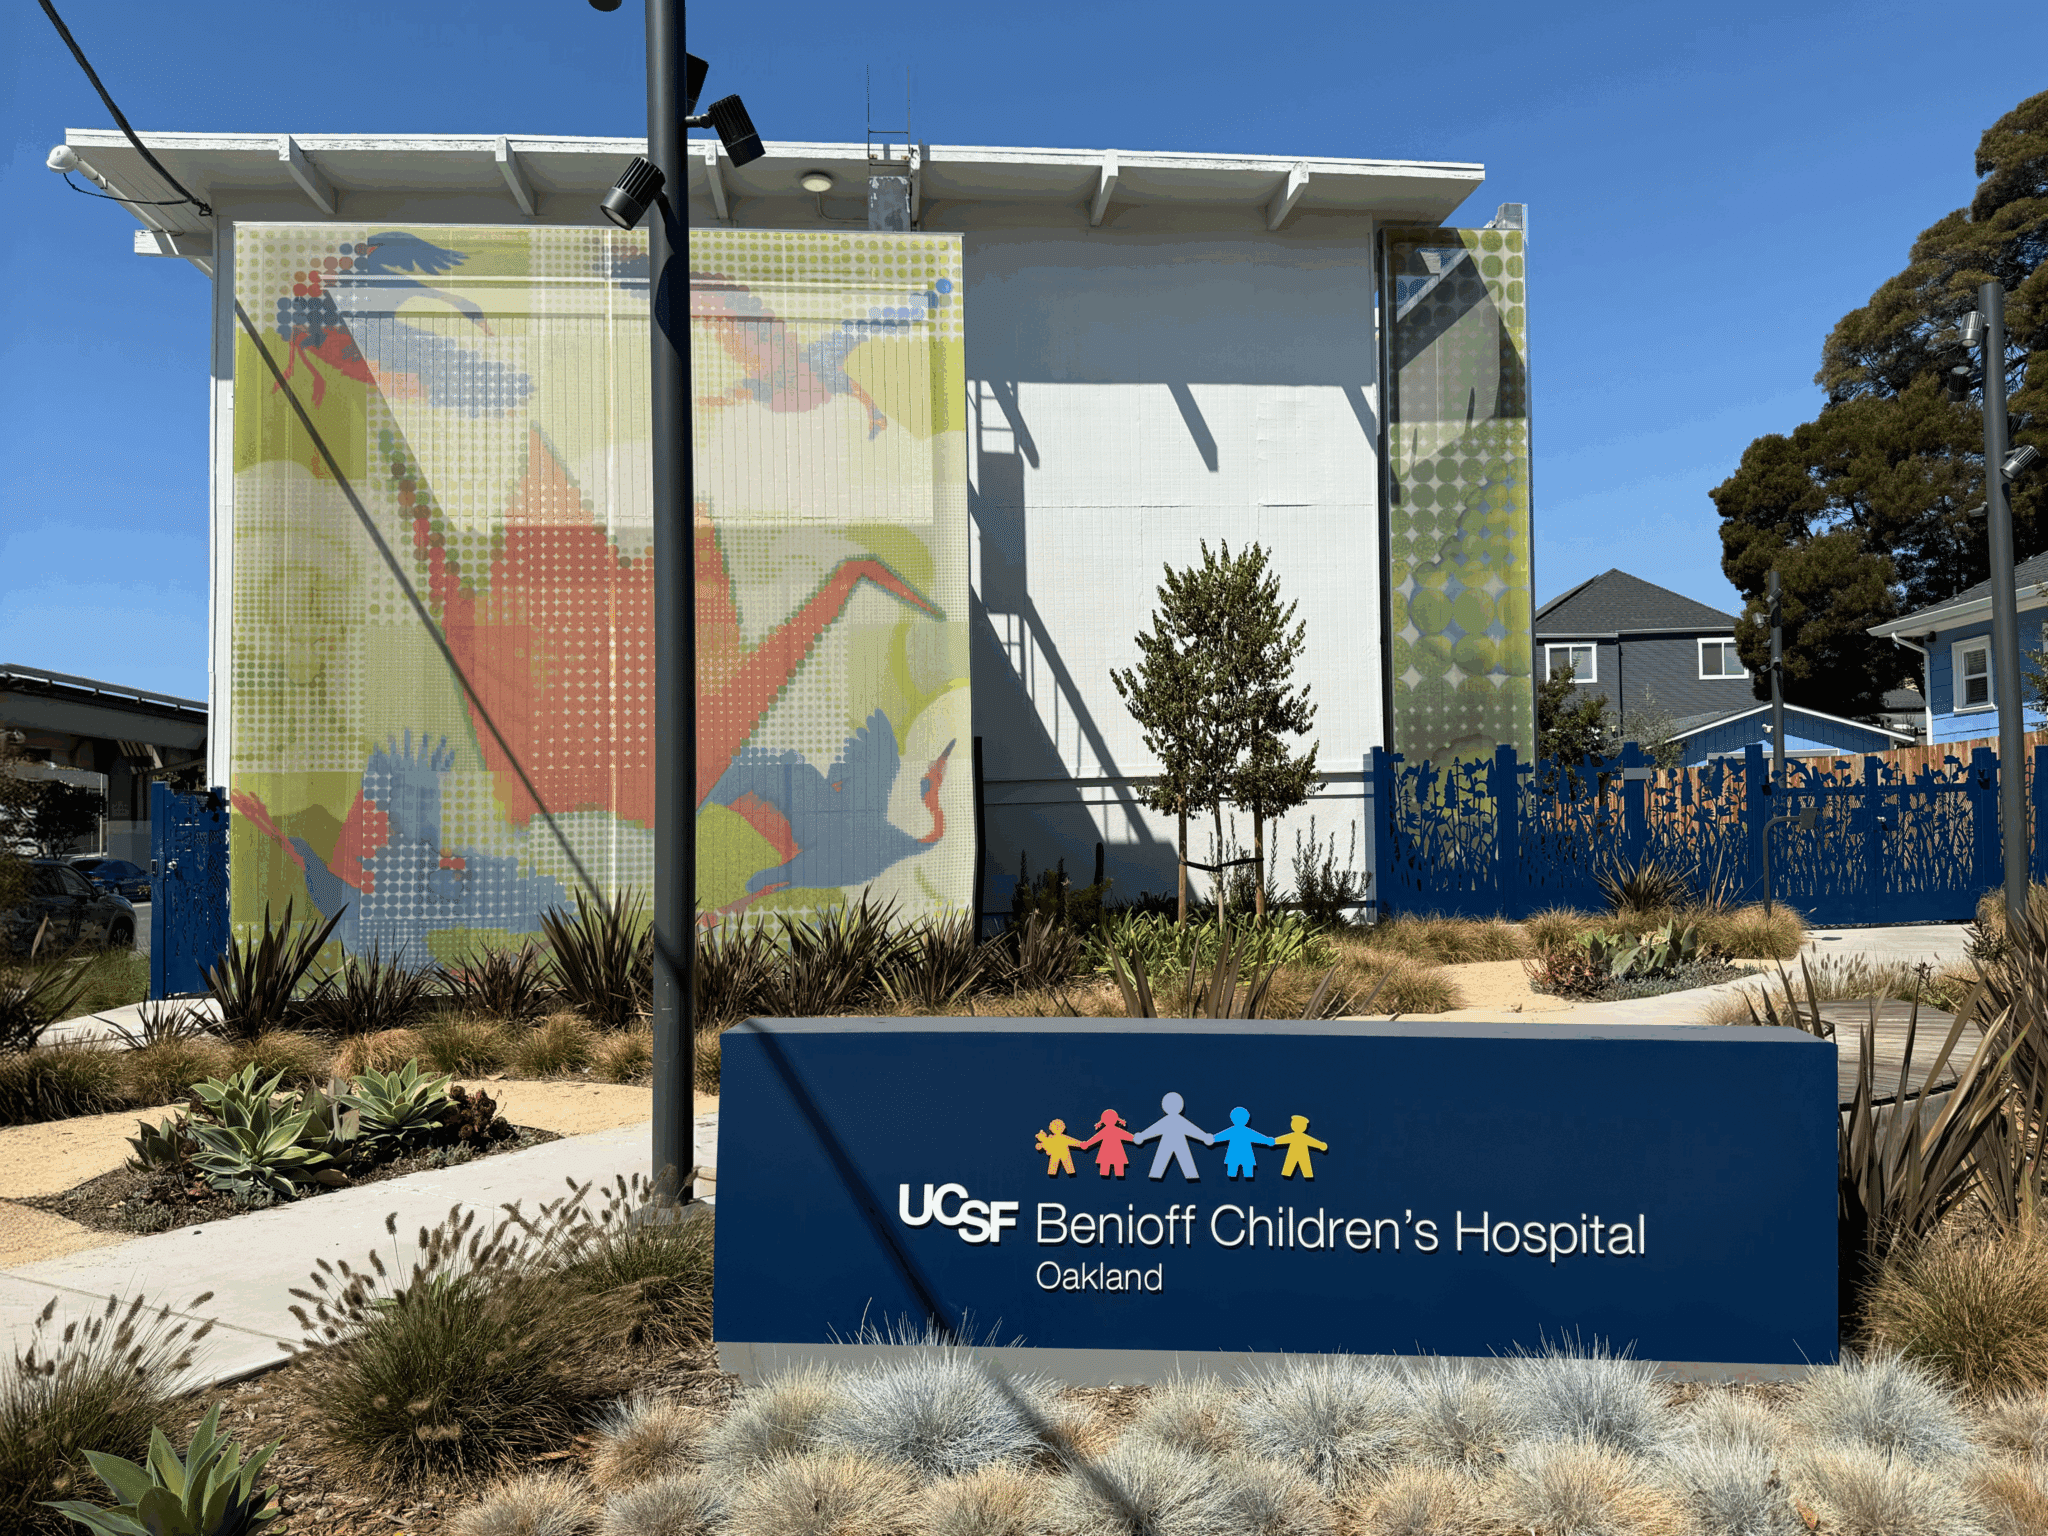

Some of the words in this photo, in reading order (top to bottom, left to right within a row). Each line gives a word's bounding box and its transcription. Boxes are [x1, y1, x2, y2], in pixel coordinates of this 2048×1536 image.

[898, 1182, 1019, 1244] UCSF
[1036, 1202, 1196, 1246] Benioff
[1210, 1204, 1439, 1252] Children's
[1456, 1210, 1648, 1264] Hospital
[1036, 1260, 1163, 1292] Oakland
